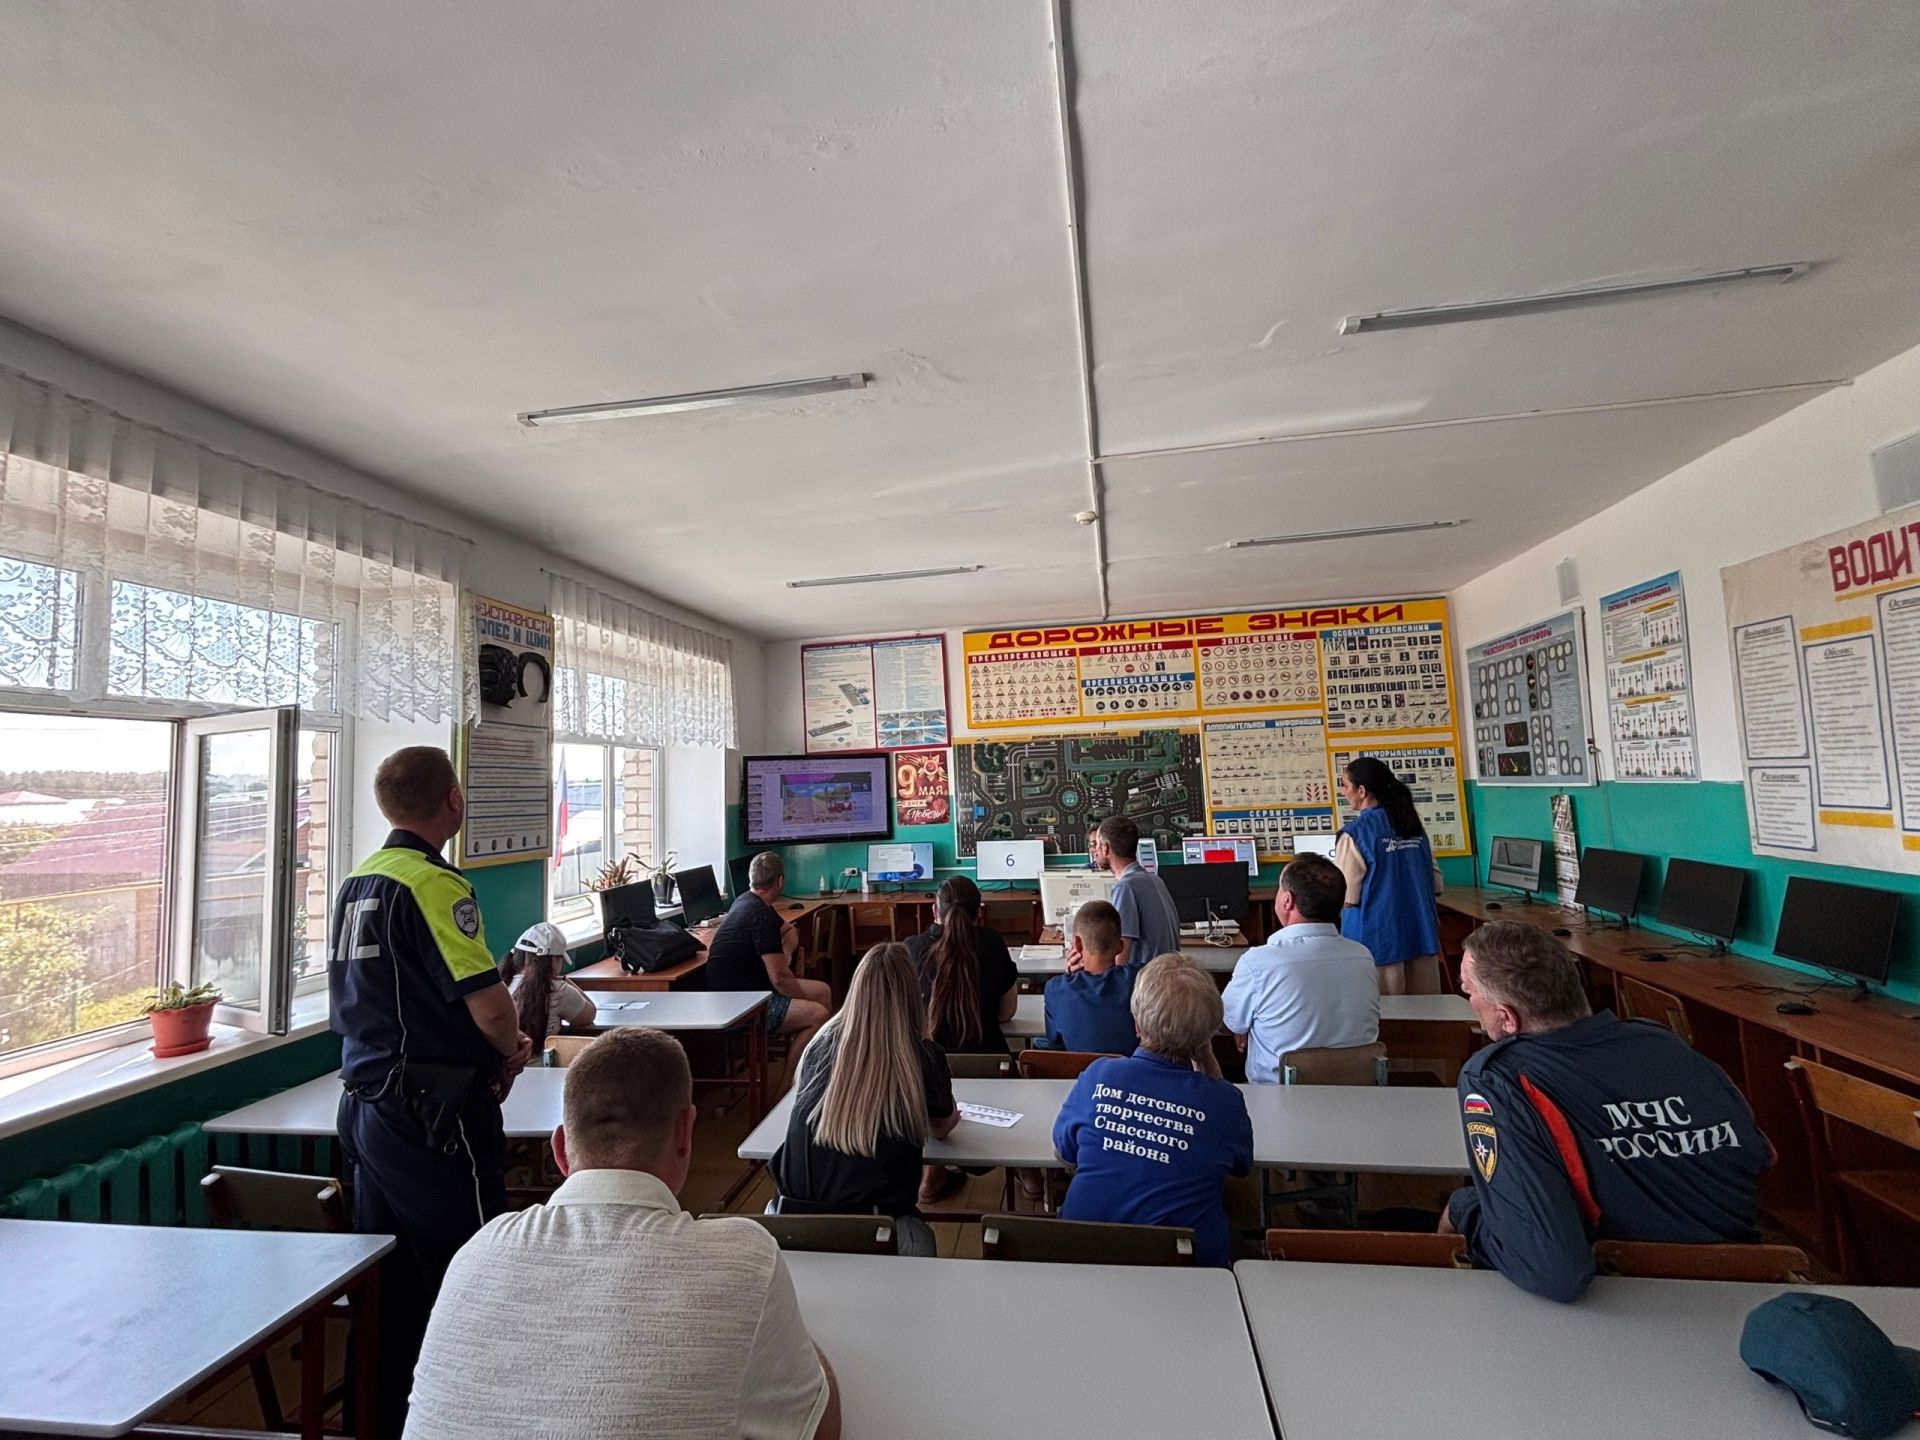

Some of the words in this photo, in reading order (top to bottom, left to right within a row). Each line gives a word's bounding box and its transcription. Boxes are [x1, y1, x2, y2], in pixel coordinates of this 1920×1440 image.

[988, 616, 1224, 649] ДОРОЖНЫЕ
[1248, 604, 1404, 631] ЗНАКИ
[1332, 628, 1365, 637] ОСОБЫХ
[526, 630, 551, 650] ШИН
[1221, 633, 1295, 645] ЗАПРЕЩАЮЩИЕ
[1100, 643, 1163, 654] ПРИОРИТЕТА
[972, 649, 1071, 663] ПРЕДУПРЕЖДАЮЩИЕ
[1085, 673, 1182, 687] ПРЕДПИСЫВАЮЩИЕ
[1206, 721, 1266, 731] ДОПОЛНИТЕЛЬНОЙ
[1275, 718, 1322, 728] ИНФОРМАЦИИ
[1363, 748, 1441, 758] ИНФОРМАЦИОННЫЕ
[898, 764, 917, 798] 9
[918, 785, 943, 796] МАЯ
[1249, 809, 1294, 818] СЕРВИСА
[1006, 853, 1015, 867] 6
[1092, 1083, 1122, 1100] Дом
[1125, 1090, 1206, 1122] детского
[1096, 1103, 1195, 1136] творчества
[1602, 1096, 1692, 1130] МЧС
[1094, 1116, 1189, 1151] Спасского
[1102, 1137, 1171, 1164] района
